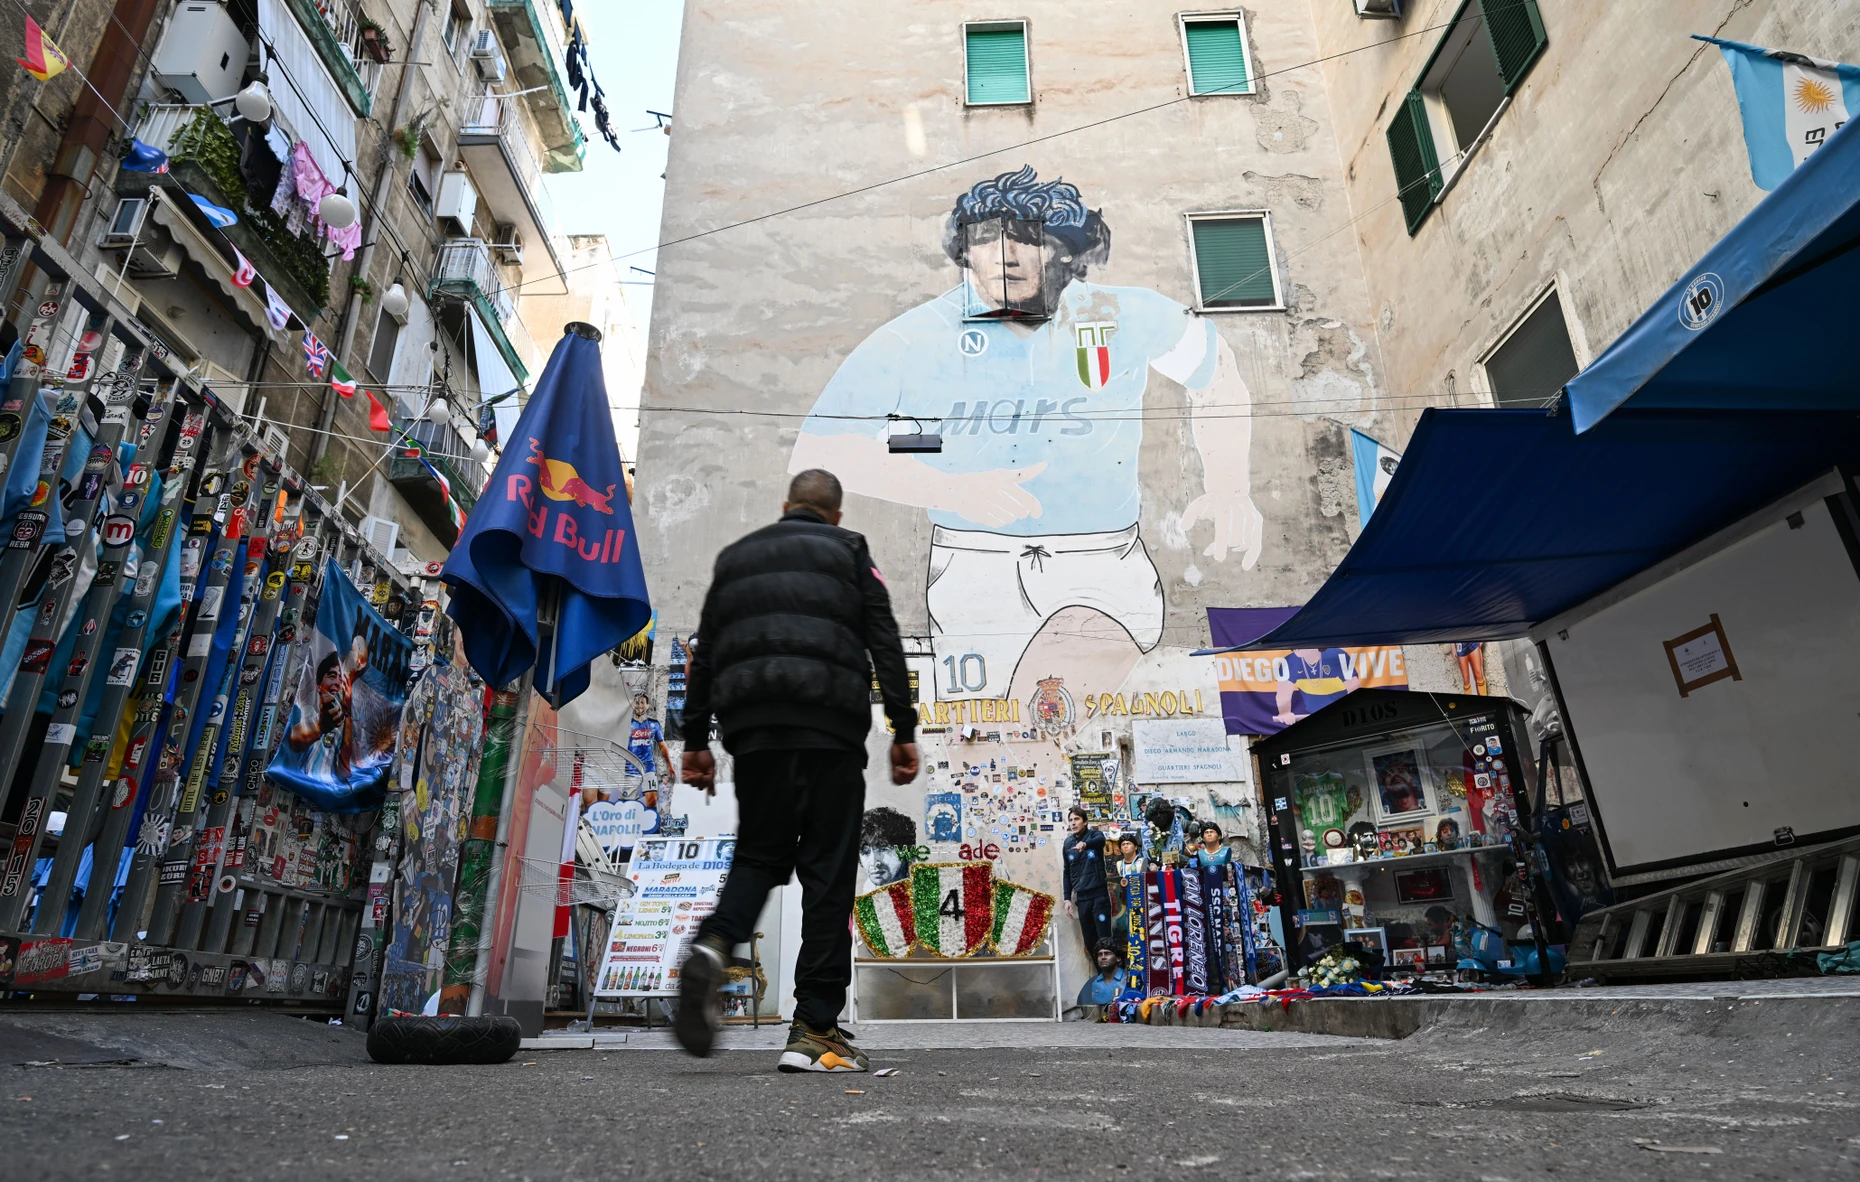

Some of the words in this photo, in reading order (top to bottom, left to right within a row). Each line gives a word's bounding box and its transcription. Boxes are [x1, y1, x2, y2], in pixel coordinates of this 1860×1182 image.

[1689, 287, 1713, 316] 10
[965, 334, 983, 351] N
[125, 470, 148, 485] 10
[107, 522, 132, 539] m
[507, 474, 548, 539] Rd
[554, 512, 626, 564] Bull
[942, 653, 988, 693] 10
[1216, 656, 1291, 682] DIEGO
[1337, 649, 1405, 682] VIVE
[900, 699, 1021, 728] ARTIERI
[1085, 689, 1204, 719] SPAGNOLI
[647, 779, 657, 790] 14
[592, 810, 622, 821] L'Oro
[624, 808, 637, 820] di
[1306, 793, 1337, 827] 10
[592, 823, 641, 836] NAPOLI!
[677, 842, 700, 860] 10
[958, 839, 1000, 861] ade
[652, 862, 687, 871] Bodega
[702, 861, 733, 870] DIOS
[1181, 868, 1204, 908] SAN
[1210, 887, 1222, 915] SSC
[938, 888, 965, 922] 4
[1507, 903, 1525, 917] 10
[1147, 884, 1168, 971] LANUS
[1163, 898, 1185, 980] TIGRE
[625, 945, 652, 953] NEGRONI
[1185, 904, 1209, 992] LORENZO
